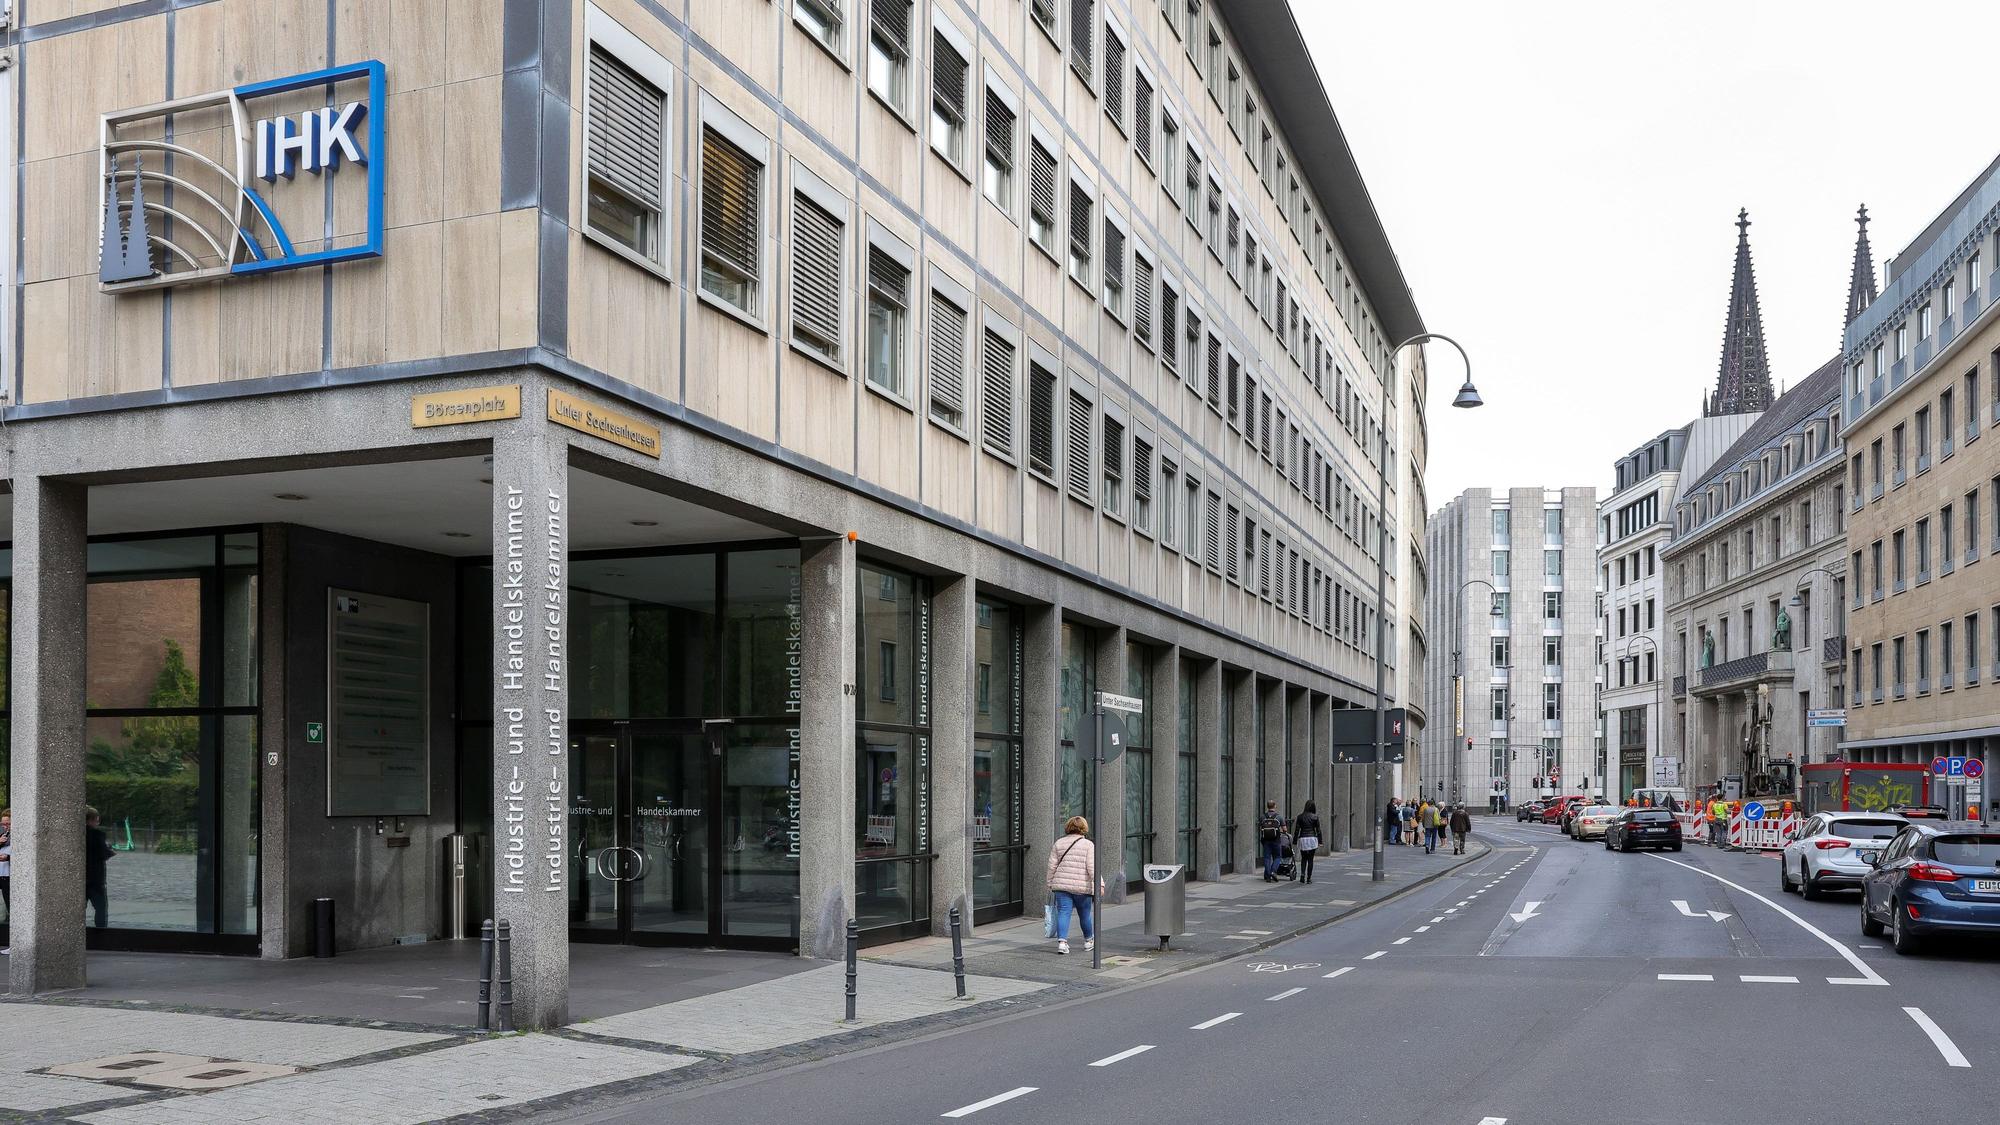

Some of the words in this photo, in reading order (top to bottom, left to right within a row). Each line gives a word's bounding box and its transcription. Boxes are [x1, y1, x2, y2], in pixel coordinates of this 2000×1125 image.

[256, 101, 364, 181] IHK
[424, 395, 506, 418] Börsenplatz
[555, 398, 583, 422] Unter
[586, 411, 656, 449] Sachsenhausen
[503, 485, 523, 690] Handelskammer
[545, 488, 561, 692] Handelskammer
[919, 599, 928, 725] Handelskammer
[1013, 625, 1022, 734] Handelskammer
[504, 708, 524, 755] und
[545, 708, 561, 756] und
[786, 728, 800, 761] und
[919, 737, 928, 766] und
[1013, 744, 1021, 770] und
[504, 766, 524, 893] Industrie-
[546, 766, 561, 892] Industrie-
[568, 806, 595, 815] ustrie-
[598, 805, 613, 815] und
[637, 806, 701, 816] Handelskammer
[786, 768, 800, 858] Industrie-
[919, 773, 928, 851] Industrie-
[1013, 775, 1021, 842] Industrie-
